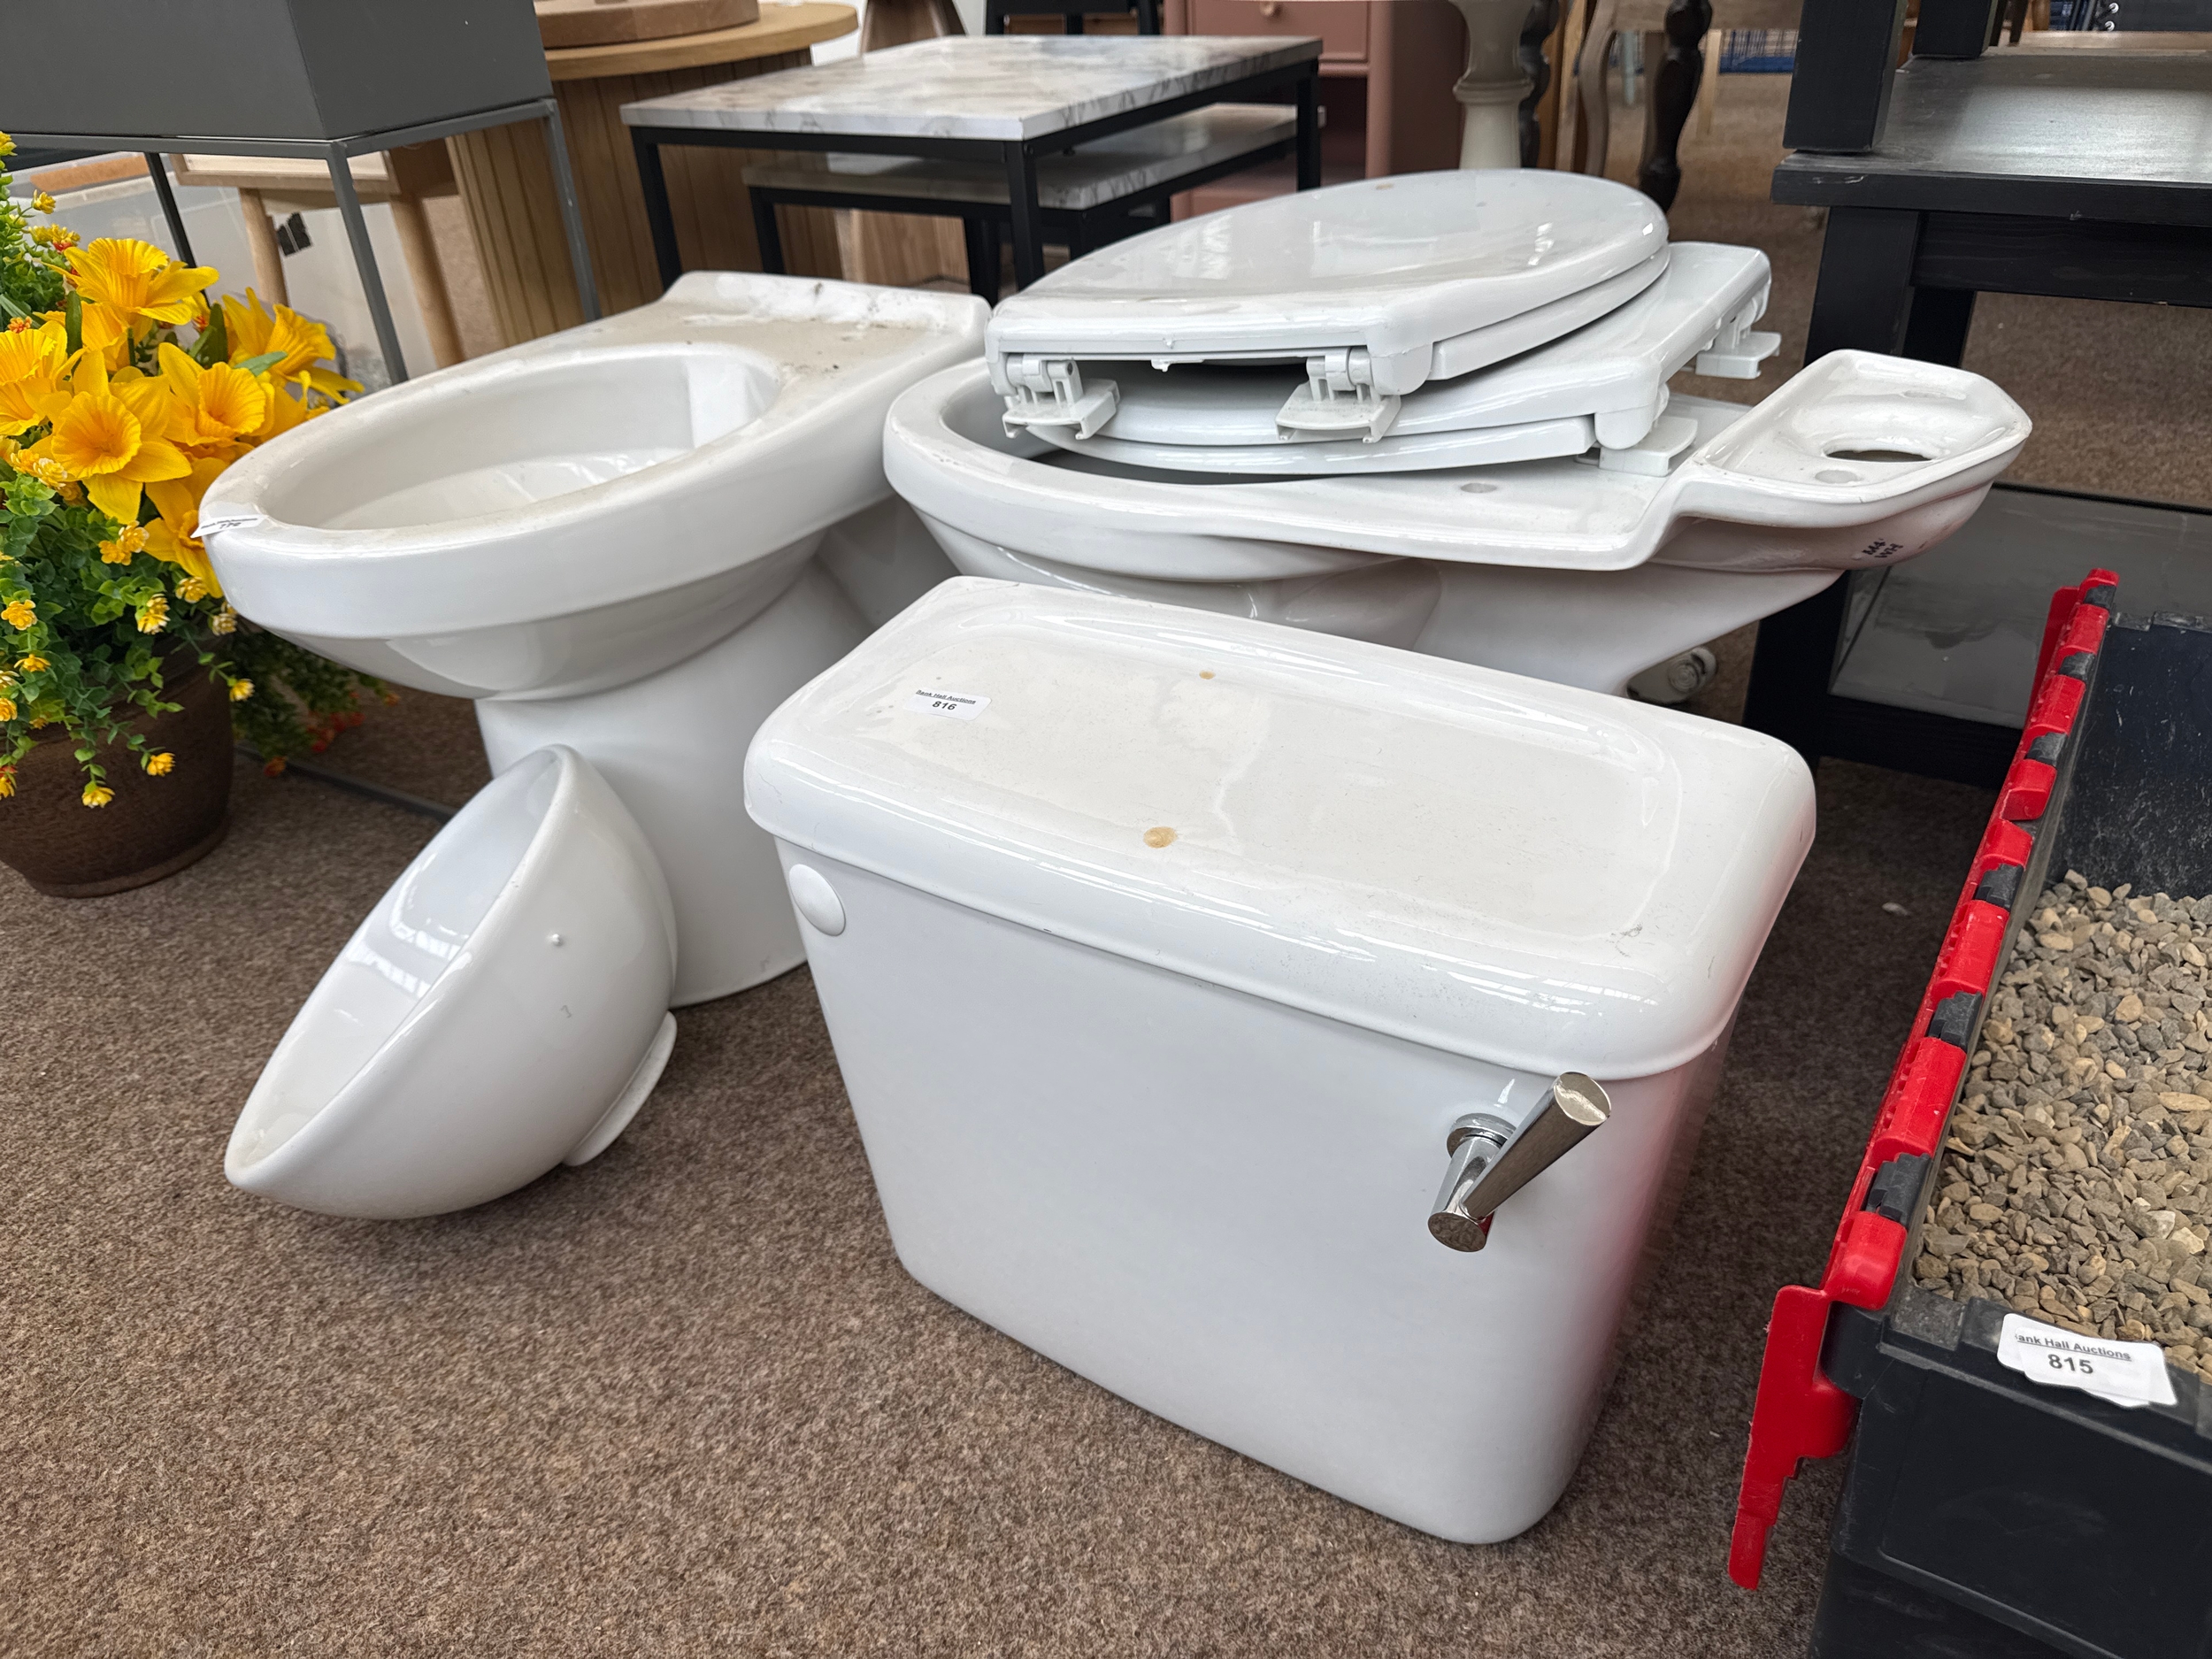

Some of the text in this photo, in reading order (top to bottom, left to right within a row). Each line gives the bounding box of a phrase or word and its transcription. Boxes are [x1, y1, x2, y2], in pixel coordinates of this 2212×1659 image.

[932, 701, 957, 710] 816
[947, 695, 977, 704] Auctions
[2015, 1333, 2131, 1361] ank Hall Auctions
[2047, 1353, 2094, 1374] 815
